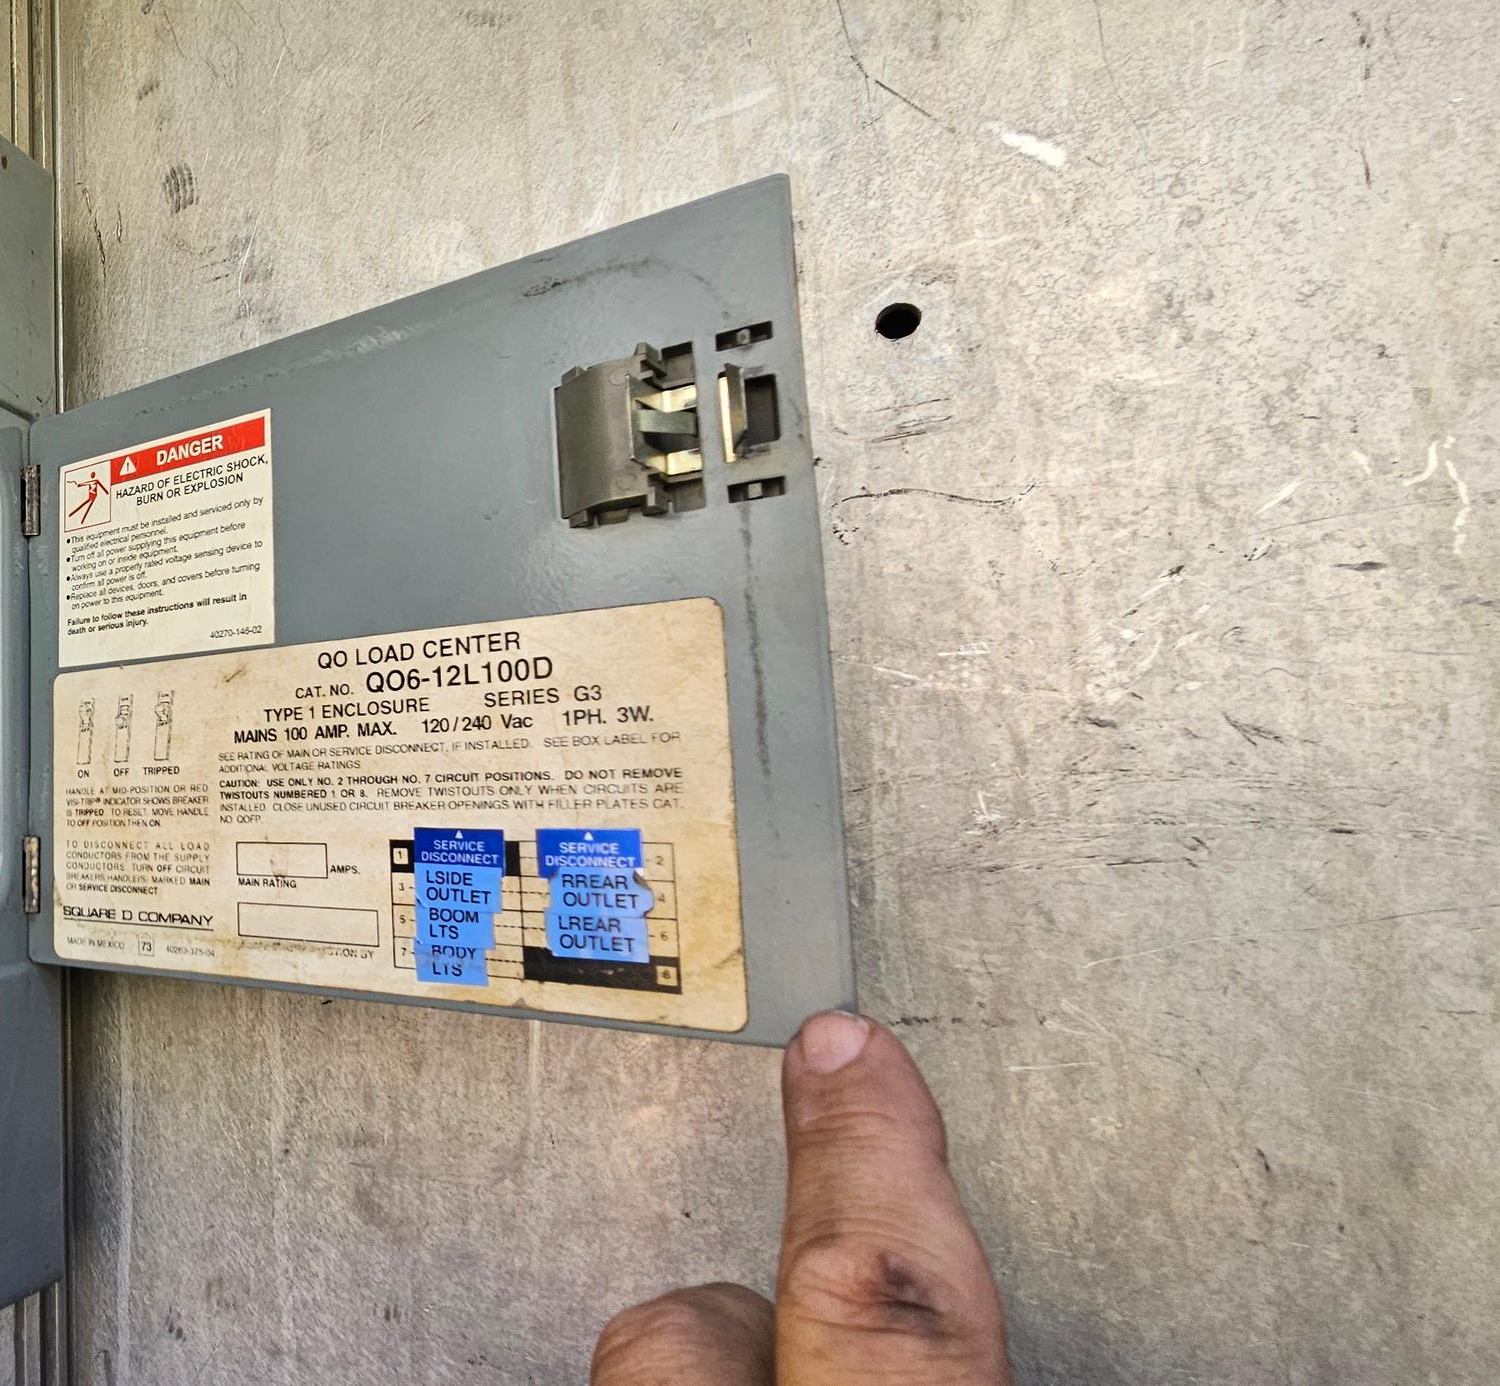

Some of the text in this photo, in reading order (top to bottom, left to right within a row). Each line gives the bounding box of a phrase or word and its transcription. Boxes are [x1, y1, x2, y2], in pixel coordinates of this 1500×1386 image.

[156, 433, 223, 466] DANGER
[115, 452, 268, 499] HAZARD OF ELECTRIC SHOCK,
[136, 472, 243, 506] BURN OR EXPLOSION
[71, 495, 263, 543] This equipment must be installed and serviced only by
[71, 541, 98, 553] qualified
[99, 535, 128, 547] electrical
[86, 551, 94, 559] off
[105, 546, 126, 556] power
[128, 538, 161, 552] supplying
[163, 534, 176, 544] this
[178, 526, 218, 542] equipment
[220, 520, 245, 533] before
[67, 591, 247, 626] Failure to follow these instructions will result in
[67, 626, 86, 635] death
[97, 621, 123, 631] serious
[126, 617, 148, 628] injury.
[317, 631, 520, 669] QO LOAD CENTER
[295, 655, 553, 699] CAT. NO. QO6-12L100D
[263, 684, 602, 722] TYPE 1 ENCLOSURE SERIES G3
[233, 728, 277, 743] MAINS
[283, 726, 307, 740] 100
[314, 723, 349, 739] AMP.
[356, 720, 396, 737] MAX.
[500, 712, 533, 729] Vac
[561, 708, 606, 726] 1PH.
[615, 705, 654, 723] 3W.
[218, 752, 234, 761] SEE
[237, 750, 269, 760] RATING
[271, 750, 283, 759] OF
[286, 748, 309, 758] MAIN
[312, 748, 326, 757] OR
[328, 746, 371, 756] SERVICE
[543, 737, 568, 748] SEE
[572, 735, 600, 747] BOX
[604, 733, 645, 745] LABEL
[651, 732, 681, 743] FOR
[77, 768, 89, 778] ON
[113, 767, 129, 777] OFF
[142, 765, 180, 775] TRIPPED
[271, 761, 315, 771] VOLTAGE
[219, 766, 682, 788] CAUTION: USE ONLY NO. 2 THROUGH NO. 7 CIRCUIT POSITIONS. DO NOT REMOVE
[219, 790, 269, 799] TWISTOUTS
[273, 789, 326, 798] NUMBERED
[331, 788, 335, 798] 1
[340, 788, 354, 798] OR
[376, 787, 421, 797] REMOVE
[427, 786, 494, 796] TWISTOUTS
[499, 785, 533, 795] ONLY
[538, 784, 577, 795] WHEN
[583, 783, 648, 794] CIRCUITS
[654, 782, 683, 793] ARE
[433, 839, 484, 851] SERVICE
[559, 841, 619, 854] SERVICE
[420, 851, 499, 864] DISCONNECT
[544, 854, 636, 868] DISCONNECT
[655, 856, 663, 865] 2
[329, 864, 360, 874] AMPS.
[237, 877, 296, 888] MAIN RATING
[425, 870, 473, 885] LSIDE
[561, 873, 628, 890] RREAR
[399, 882, 404, 890] 3
[425, 887, 491, 904] OUTLET
[562, 891, 639, 910] OUTLET
[62, 904, 213, 927] SQUARE D COMPANY
[399, 915, 405, 923] 5
[428, 907, 479, 923] BOOM
[428, 923, 459, 939] LTS
[557, 915, 621, 933] LREAR
[558, 933, 635, 954] OUTLET
[660, 931, 668, 941] 6
[141, 940, 151, 952] 73
[400, 947, 406, 956] 7
[431, 944, 476, 960] BODY
[432, 962, 462, 977] LTS
[661, 969, 670, 979] 8
